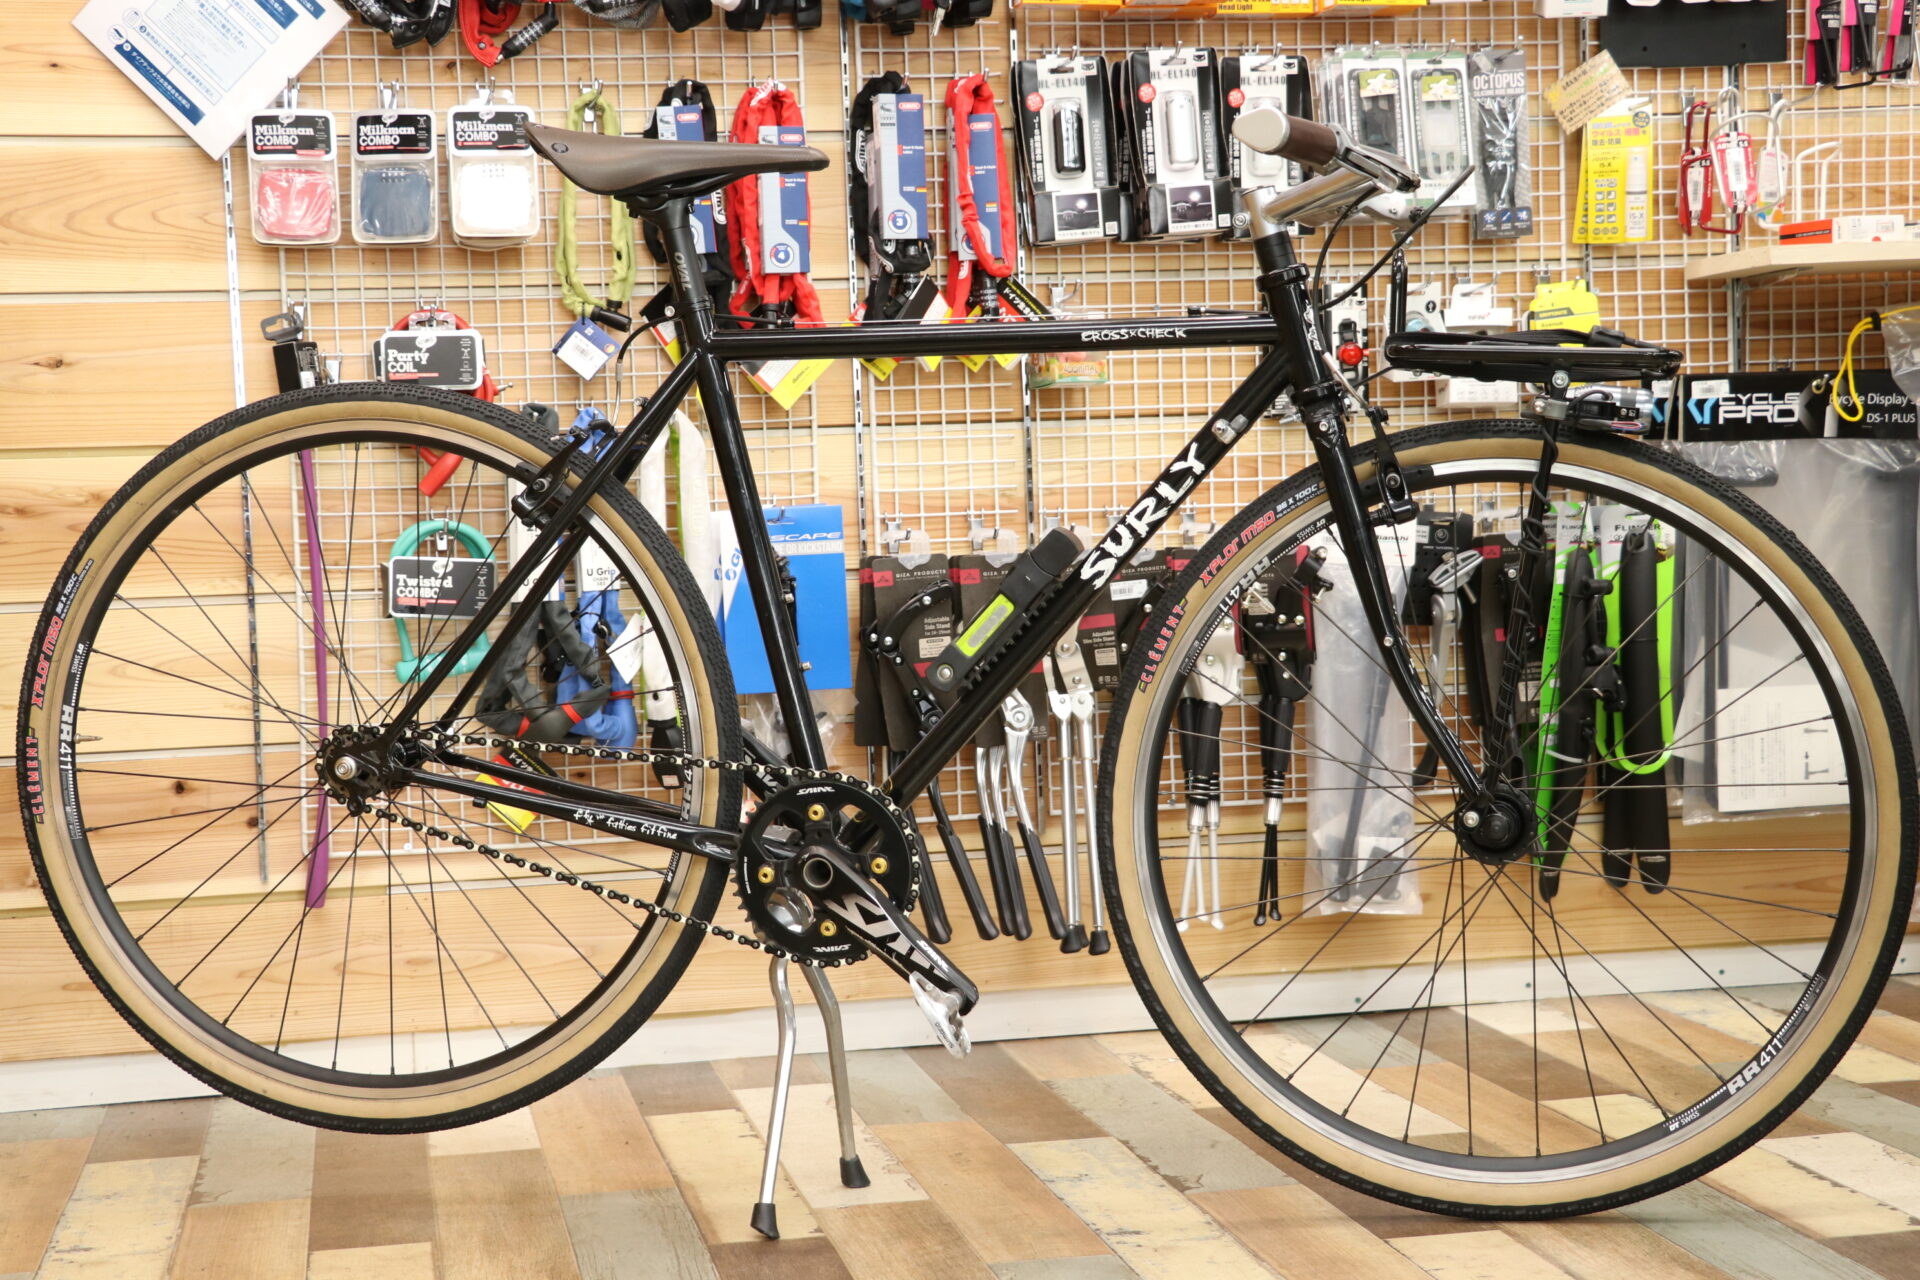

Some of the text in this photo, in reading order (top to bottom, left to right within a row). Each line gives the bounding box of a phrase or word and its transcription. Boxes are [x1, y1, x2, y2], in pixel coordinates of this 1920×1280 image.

[1150, 68, 1197, 80] HL-EL140
[1038, 77, 1086, 89] HL-EL140
[1240, 75, 1286, 86] HL-EL140
[1473, 71, 1524, 91] OCTOPUS
[255, 124, 315, 136] Milkman
[359, 124, 416, 135] Milkman
[456, 120, 514, 132] Milkman
[255, 135, 299, 146] COMBO
[359, 135, 401, 146] COMBO
[456, 132, 498, 142] COMBO
[387, 349, 429, 364] Party
[388, 362, 417, 373] COIL
[1719, 393, 1800, 405] CYCLE
[1867, 393, 1908, 407] Display
[1718, 405, 1800, 425] PRO
[1866, 412, 1916, 423] DS-1 PLUS
[1080, 442, 1205, 590] SURLY
[913, 569, 947, 577] PRODUCTS
[396, 574, 453, 589] Twisted
[1219, 556, 1272, 613] RR 411
[396, 587, 440, 599] COMBO
[60, 704, 75, 742] RR
[60, 742, 73, 770] 411
[1726, 1037, 1783, 1096] RR 411
[1680, 1110, 1700, 1125] SWISS
